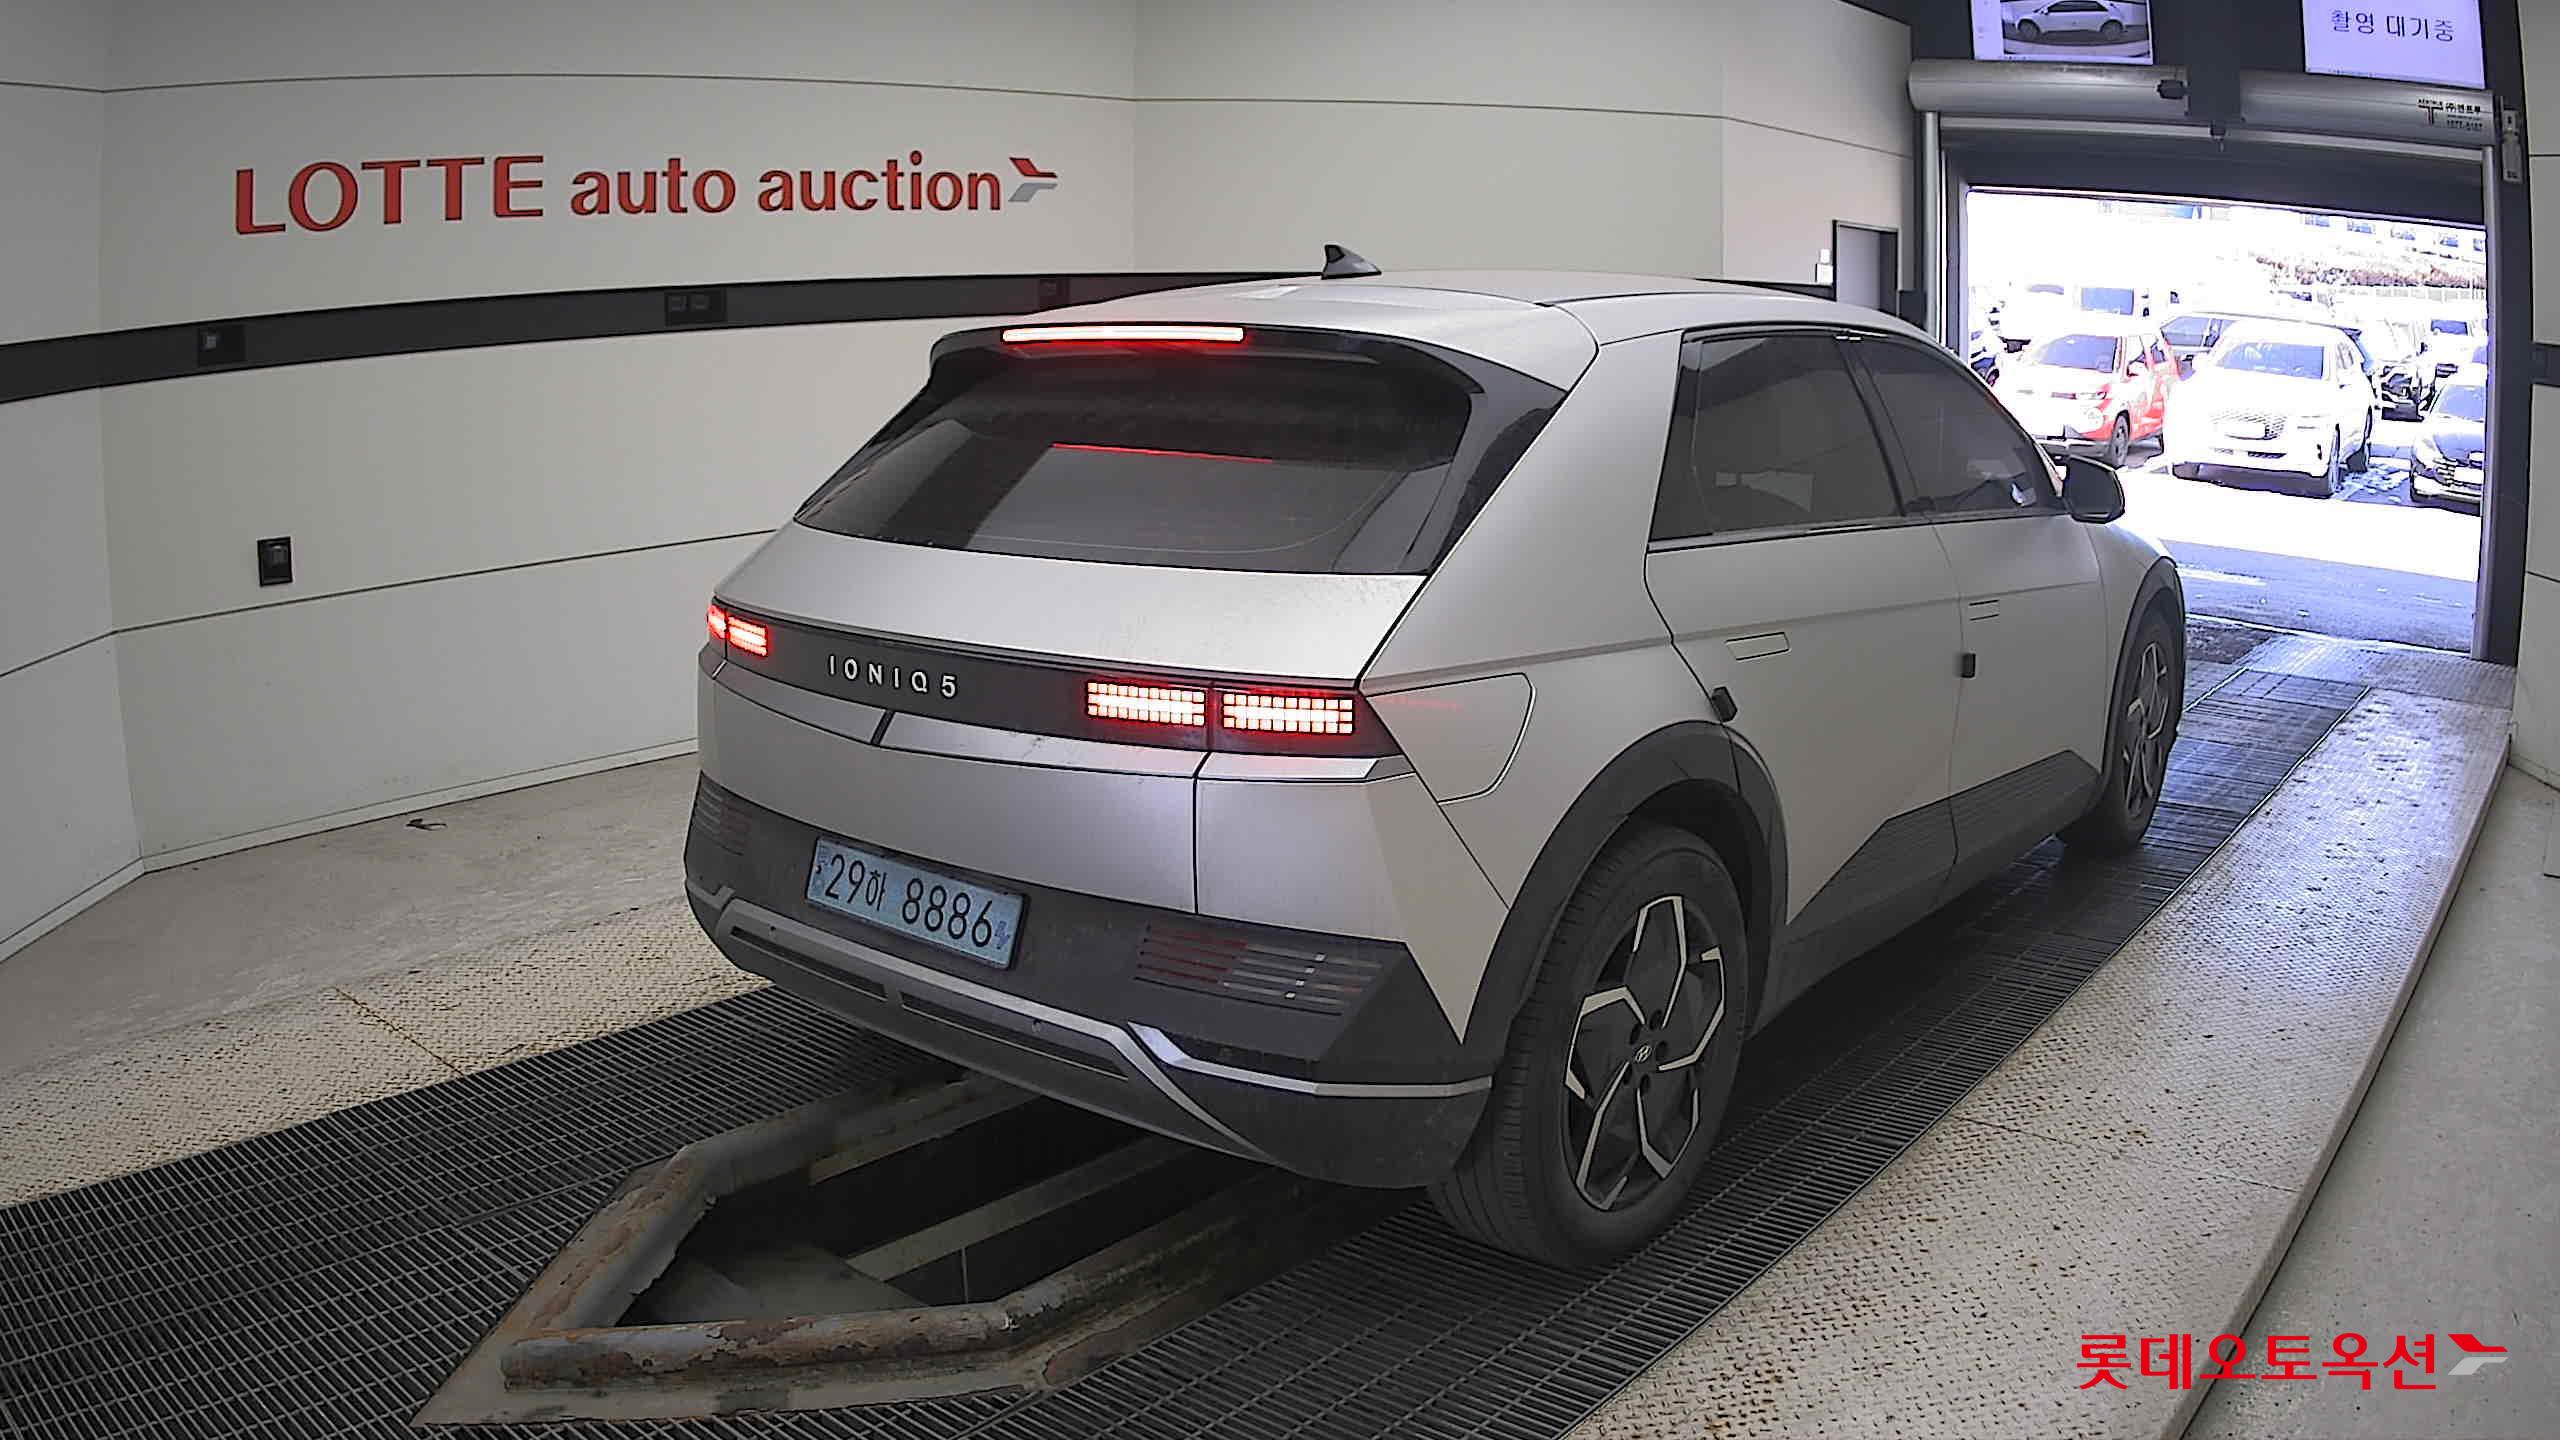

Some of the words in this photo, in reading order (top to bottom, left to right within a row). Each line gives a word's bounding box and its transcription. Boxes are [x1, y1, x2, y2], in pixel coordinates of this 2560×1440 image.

[2331, 10, 2375, 34] 촬영
[2386, 15, 2455, 42] 대기중
[236, 155, 544, 235] LOTTE
[570, 158, 736, 216] auto
[758, 150, 1001, 212] auction
[829, 655, 928, 693] IONIQ
[941, 675, 956, 698] 5
[825, 854, 887, 912] 29하
[902, 878, 993, 948] 8886
